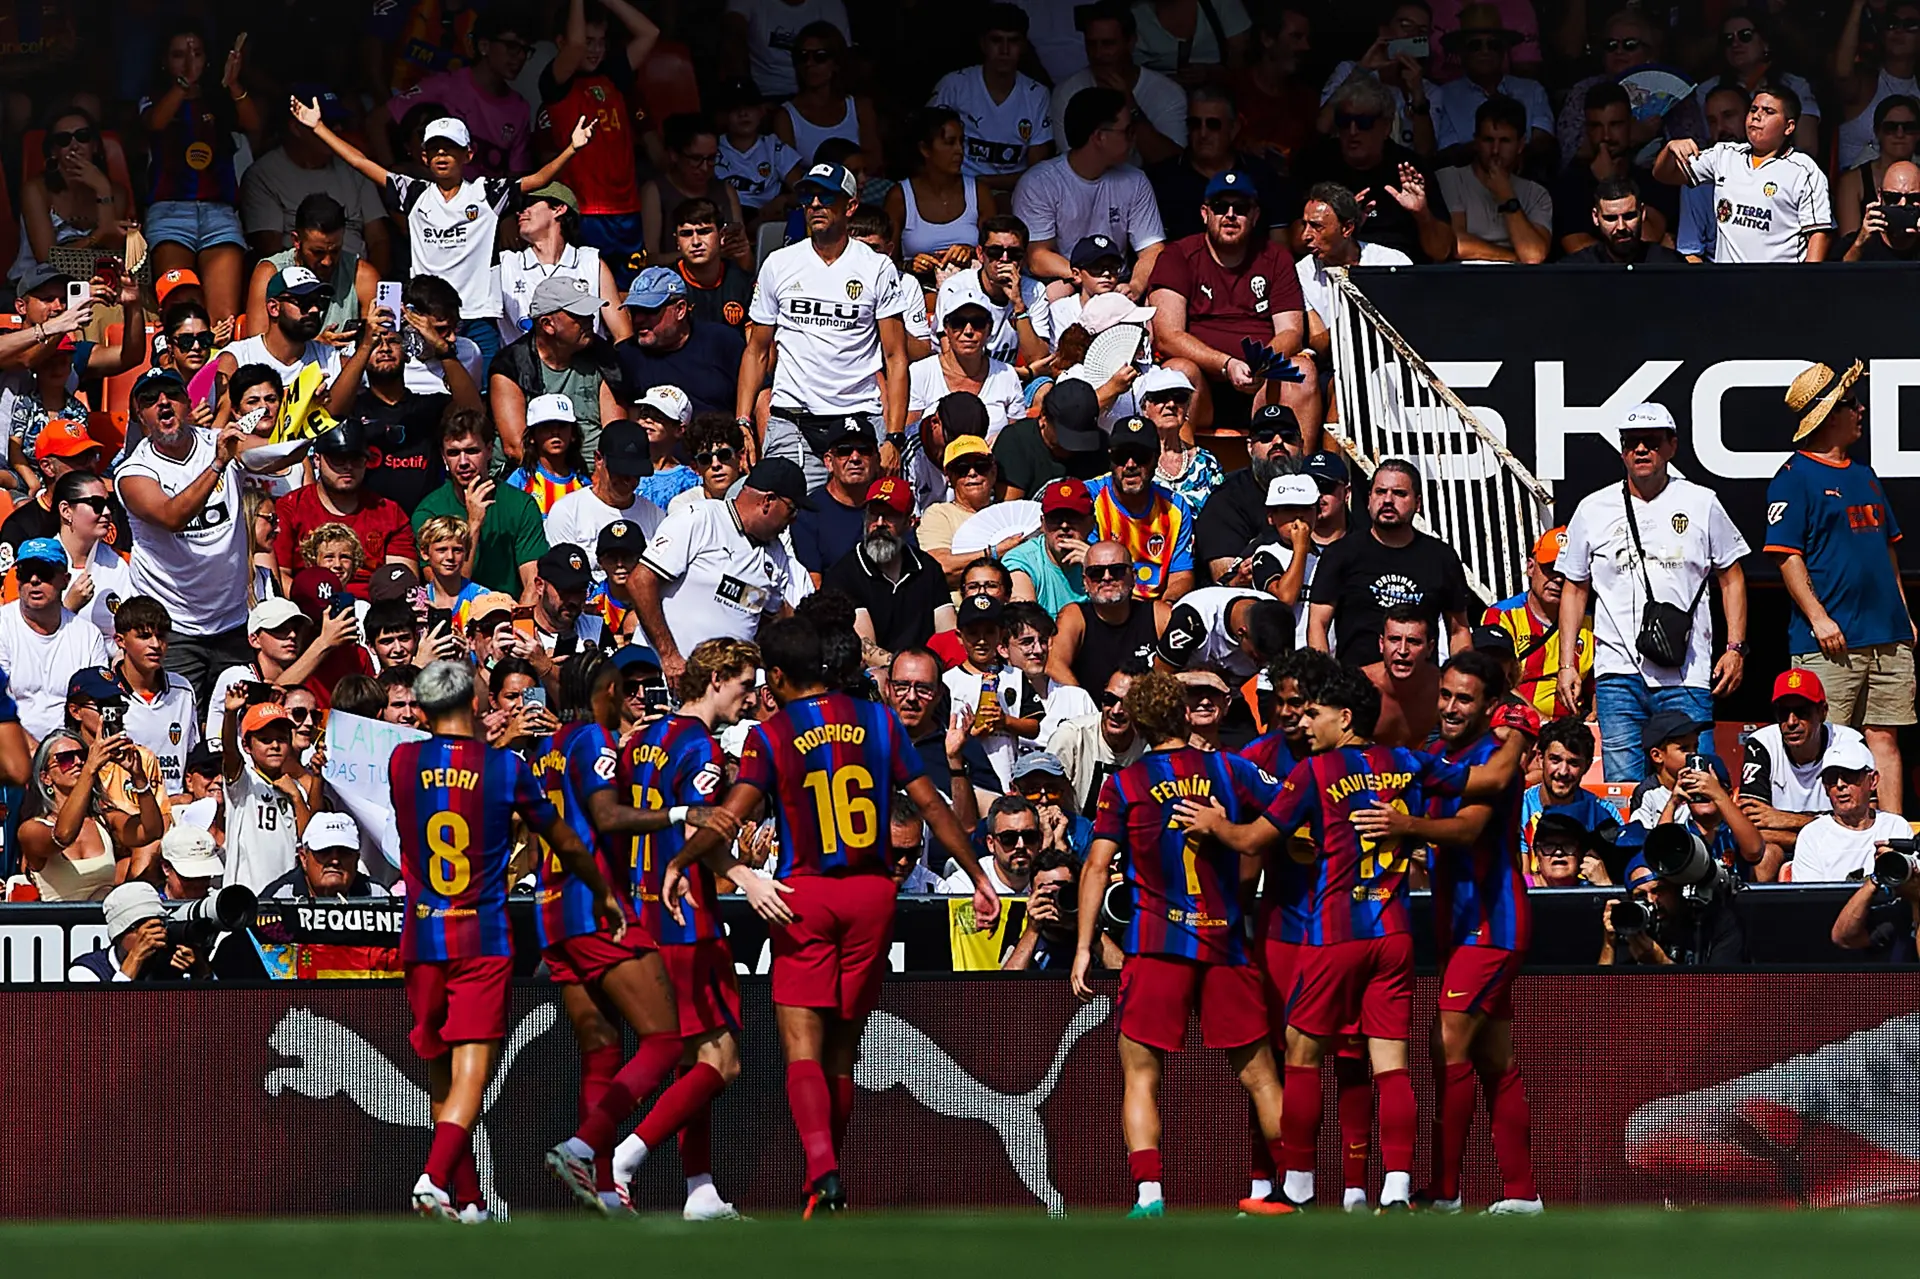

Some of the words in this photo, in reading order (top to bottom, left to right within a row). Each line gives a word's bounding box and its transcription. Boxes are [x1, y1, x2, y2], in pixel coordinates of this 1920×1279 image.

[597, 107, 621, 131] 24
[1736, 204, 1773, 221] TERRA
[790, 299, 859, 320] BLU
[556, 400, 568, 411] 10
[384, 454, 428, 470] Spotify
[722, 580, 741, 598] TM
[793, 723, 866, 755] RODRIGO
[421, 767, 479, 791] PEDRI
[257, 805, 278, 831] 19
[803, 764, 878, 854] 16
[426, 811, 471, 896] 8
[297, 907, 405, 933] REQUENE
